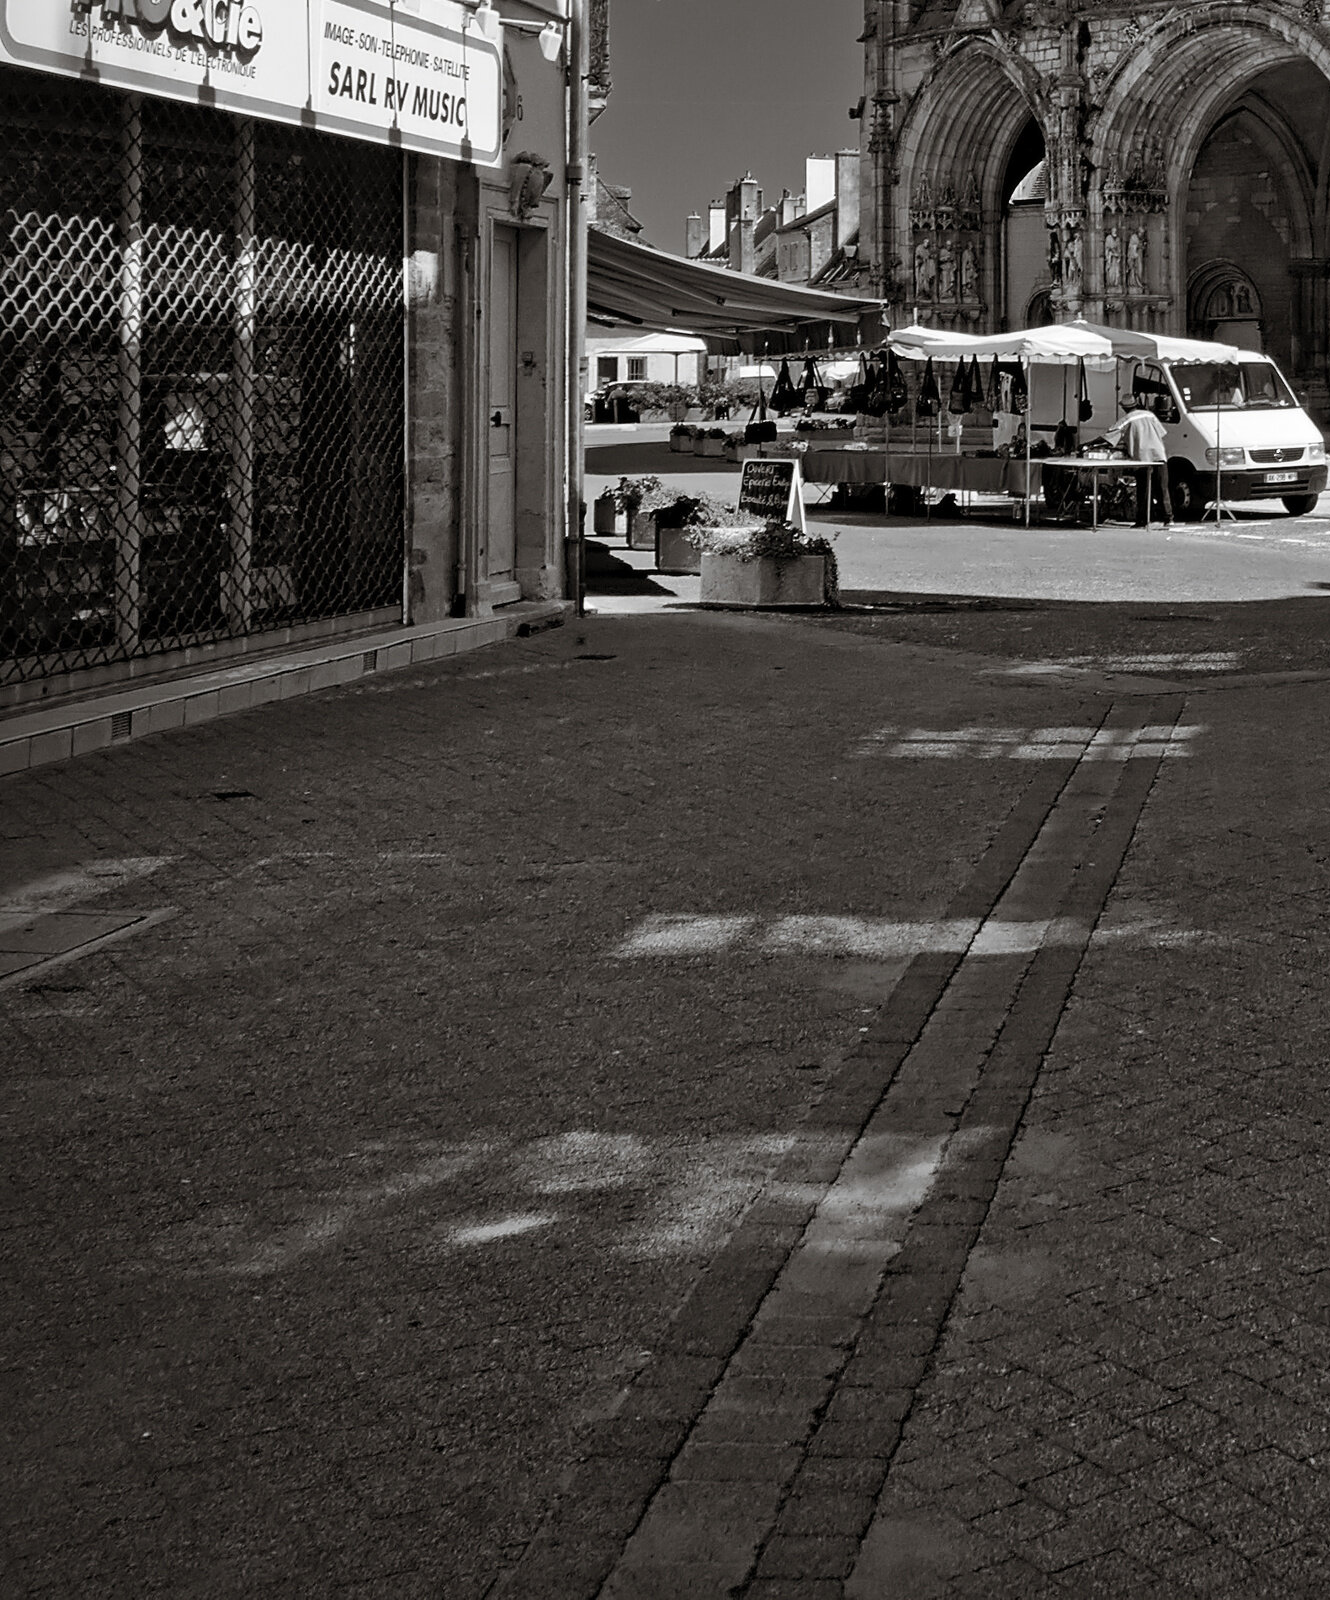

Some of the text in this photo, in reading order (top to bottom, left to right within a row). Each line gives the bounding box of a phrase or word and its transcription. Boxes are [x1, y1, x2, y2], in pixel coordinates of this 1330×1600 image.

[69, 20, 88, 37] LES
[92, 25, 173, 59] PROFESSIONNELS
[175, 47, 188, 63] DE
[328, 61, 467, 127] SARL RV MUSIC
